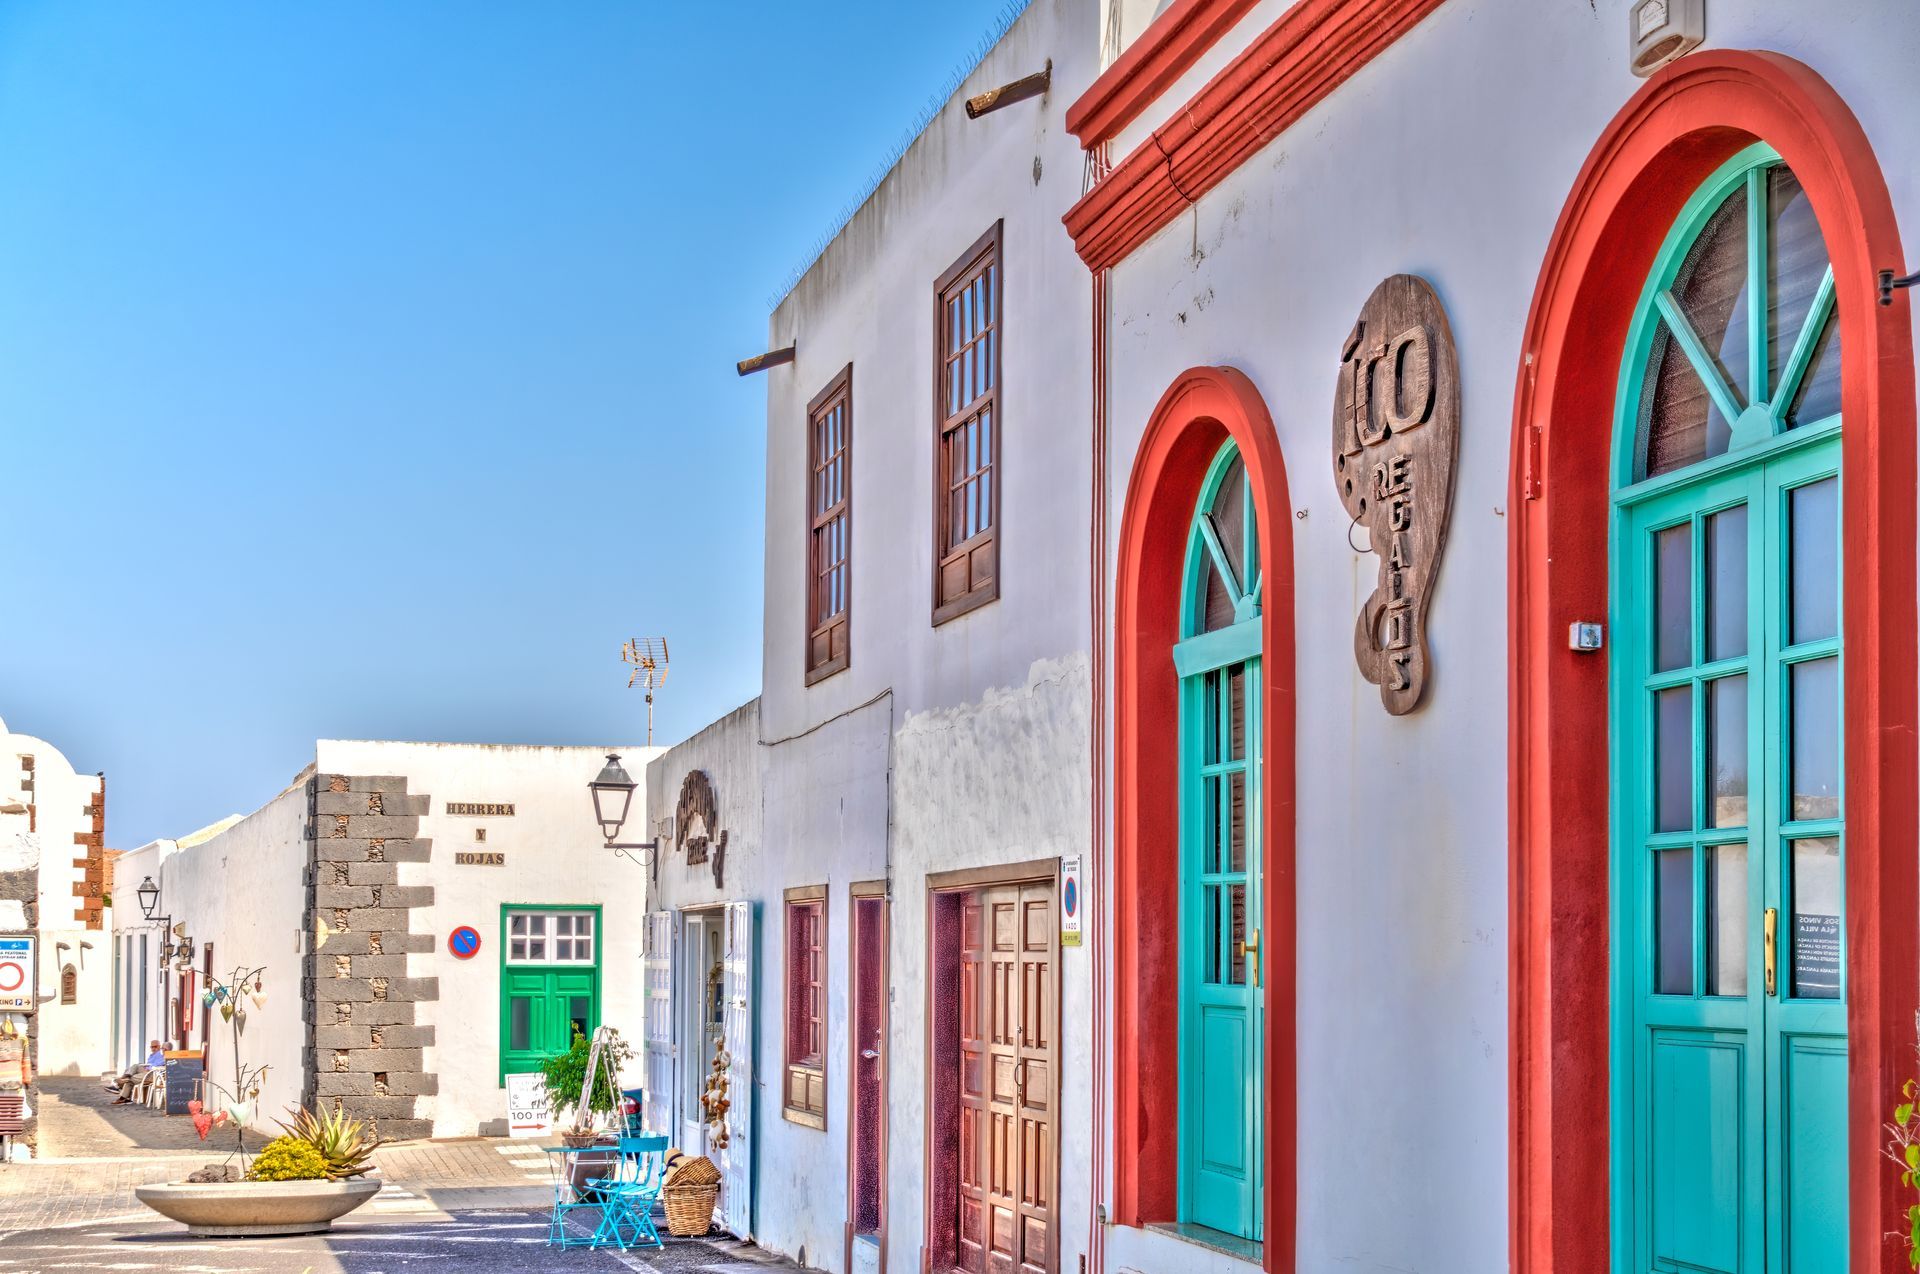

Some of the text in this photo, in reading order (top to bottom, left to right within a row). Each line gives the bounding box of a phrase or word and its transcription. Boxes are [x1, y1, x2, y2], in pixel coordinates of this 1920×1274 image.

[447, 803, 515, 815] HERRERA
[476, 829, 486, 841] Y
[455, 853, 504, 865] ROJAS
[512, 1112, 532, 1120] 100
